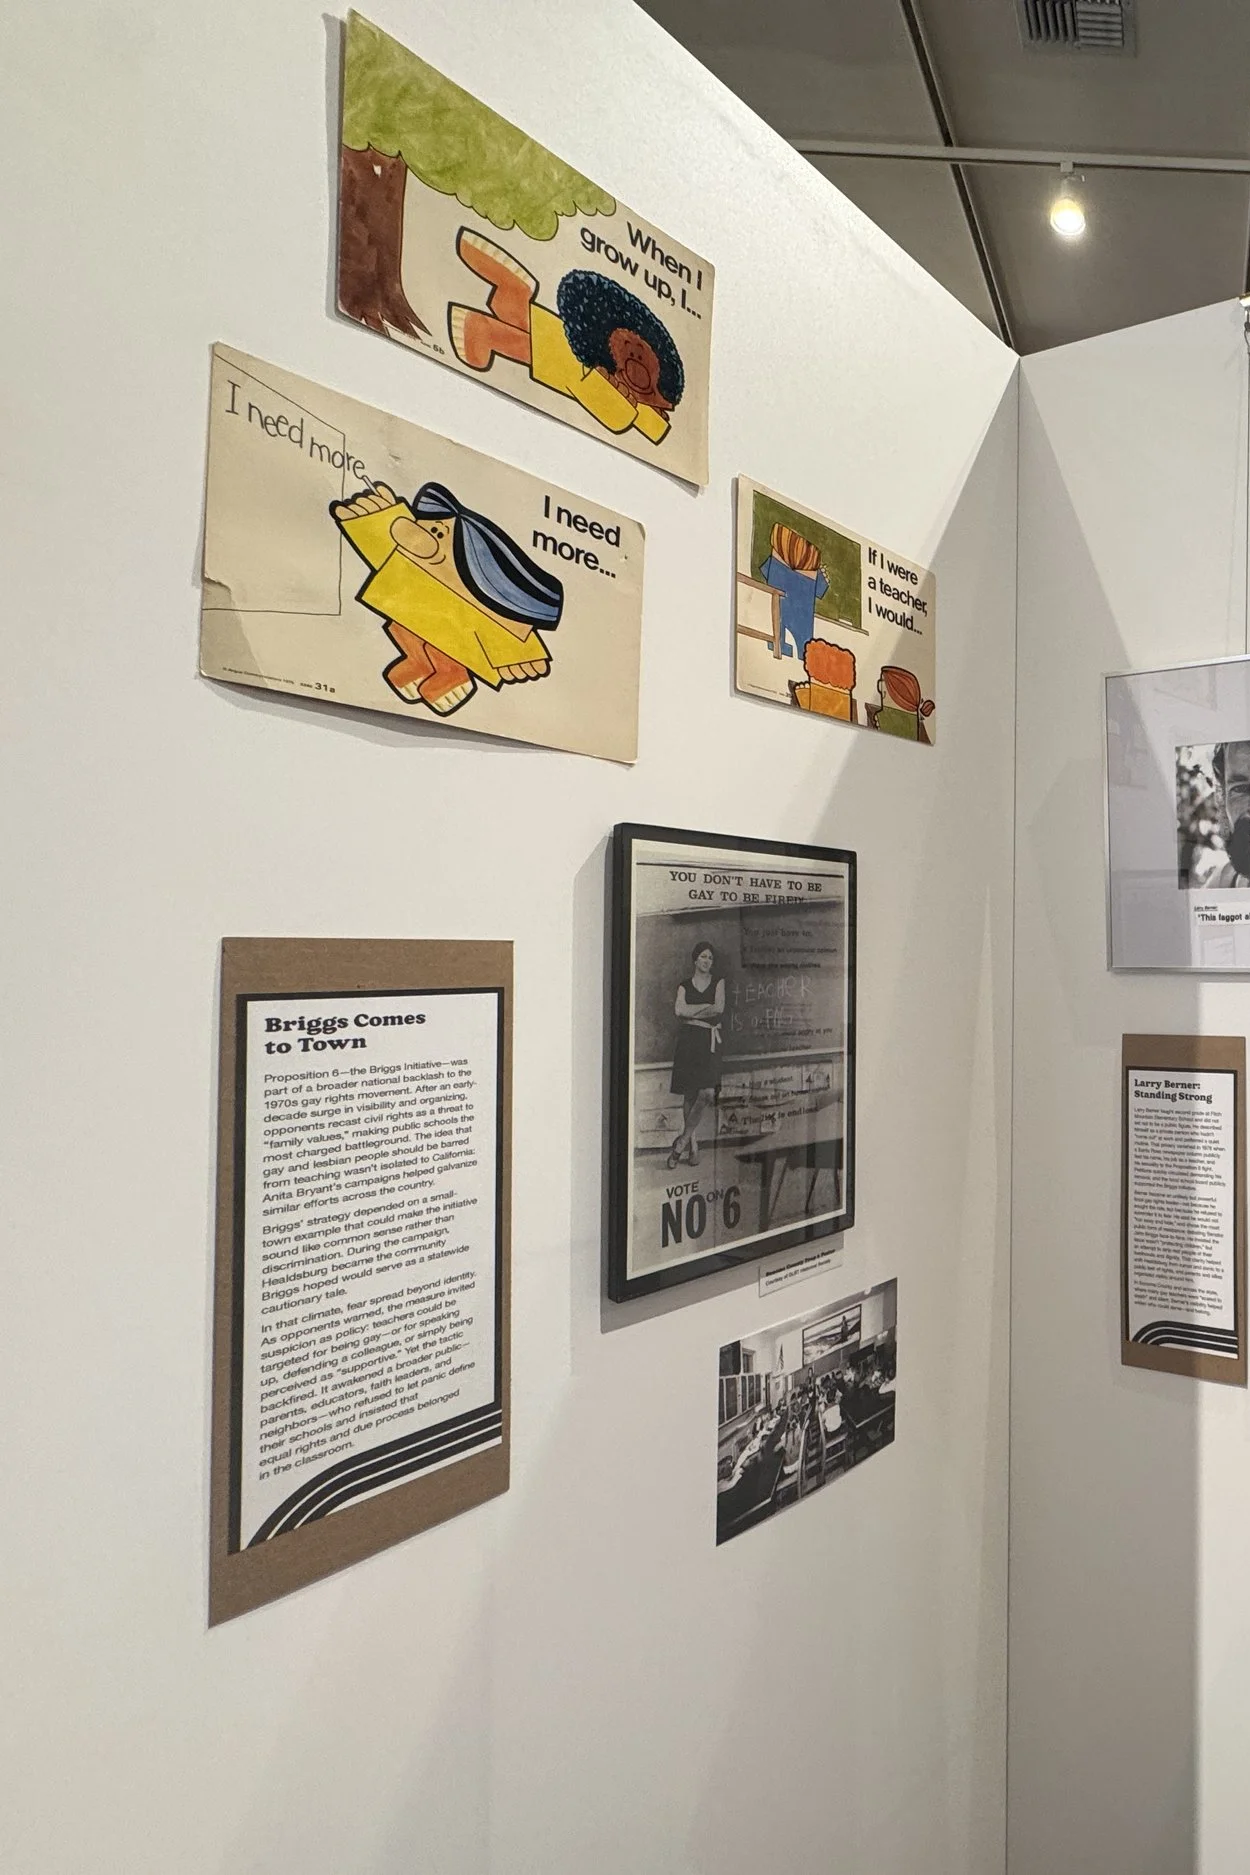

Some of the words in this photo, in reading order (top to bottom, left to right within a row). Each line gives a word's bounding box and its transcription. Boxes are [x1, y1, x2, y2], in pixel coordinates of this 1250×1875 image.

[626, 221, 692, 284] When
[696, 269, 703, 291] I
[580, 227, 640, 277] grow
[643, 269, 676, 307] up,
[681, 288, 702, 320] I...
[225, 379, 242, 415] I
[248, 402, 304, 448] need
[309, 437, 366, 480] more
[544, 494, 551, 519] I
[556, 506, 621, 548] need
[532, 529, 616, 579] more...
[868, 546, 878, 566] If
[880, 552, 884, 569] I
[886, 559, 919, 586] were
[867, 576, 877, 591] a
[878, 577, 928, 617] teacher,
[868, 596, 872, 614] I
[875, 603, 923, 635] would...
[314, 682, 336, 694] 31a
[669, 871, 697, 883] YOU
[703, 873, 743, 887] DON'T
[750, 878, 782, 889] HAVE
[787, 880, 803, 891] TO
[808, 882, 822, 892] BE
[688, 889, 715, 900] GAY
[720, 891, 738, 902] TO
[743, 893, 760, 904] BE
[1218, 913, 1242, 922] faggot
[264, 1016, 349, 1035] Briggs
[353, 1013, 426, 1028] Comes
[264, 1041, 292, 1055] to
[297, 1037, 367, 1053] Town
[263, 1086, 288, 1098] part
[291, 1084, 303, 1094] of
[305, 1085, 313, 1093] a
[316, 1080, 358, 1091] broader
[360, 1075, 400, 1087] national
[402, 1071, 444, 1083] backlash
[458, 1069, 471, 1077] the
[264, 1070, 329, 1083] Proposition
[369, 1065, 401, 1075] Briggs
[1134, 1078, 1162, 1089] Larry
[1164, 1080, 1200, 1090] Berner:
[263, 1110, 307, 1123] decade
[310, 1108, 341, 1118] surge
[344, 1104, 353, 1114] in
[356, 1100, 396, 1112] visibility
[398, 1097, 417, 1107] and
[264, 1098, 298, 1109] 1970s
[301, 1096, 322, 1108] gay
[324, 1093, 355, 1105] rights
[414, 1084, 437, 1093] After
[1134, 1090, 1177, 1102] Standing
[1178, 1092, 1213, 1104] Strong
[263, 1122, 325, 1137] opponents
[327, 1117, 361, 1128] recast
[363, 1113, 383, 1124] civil
[385, 1111, 413, 1122] rights
[415, 1109, 427, 1117] as
[437, 1104, 463, 1114] threat
[351, 1126, 389, 1138] making
[391, 1121, 421, 1134] public
[423, 1116, 458, 1128] schools
[460, 1114, 474, 1122] the
[262, 1151, 293, 1163] most
[295, 1144, 342, 1158] charged
[344, 1134, 411, 1151] battleground.
[414, 1132, 432, 1140] The
[434, 1129, 453, 1137] idea
[455, 1125, 472, 1134] that
[262, 1166, 284, 1178] gay
[287, 1161, 309, 1172] and
[313, 1156, 351, 1169] lesbian
[354, 1150, 389, 1164] people
[391, 1143, 424, 1156] should
[426, 1143, 438, 1151] be
[440, 1136, 469, 1148] barred
[262, 1179, 290, 1189] from
[293, 1171, 341, 1184] teaching
[380, 1156, 418, 1170] isolated
[420, 1156, 430, 1164] to
[262, 1191, 293, 1203] Anita
[344, 1173, 401, 1189] campaigns
[402, 1165, 435, 1179] helped
[437, 1159, 477, 1174] galvanize
[666, 1181, 700, 1199] VOTE
[662, 1194, 706, 1249] NO
[706, 1189, 725, 1203] ON
[723, 1185, 741, 1229] 6
